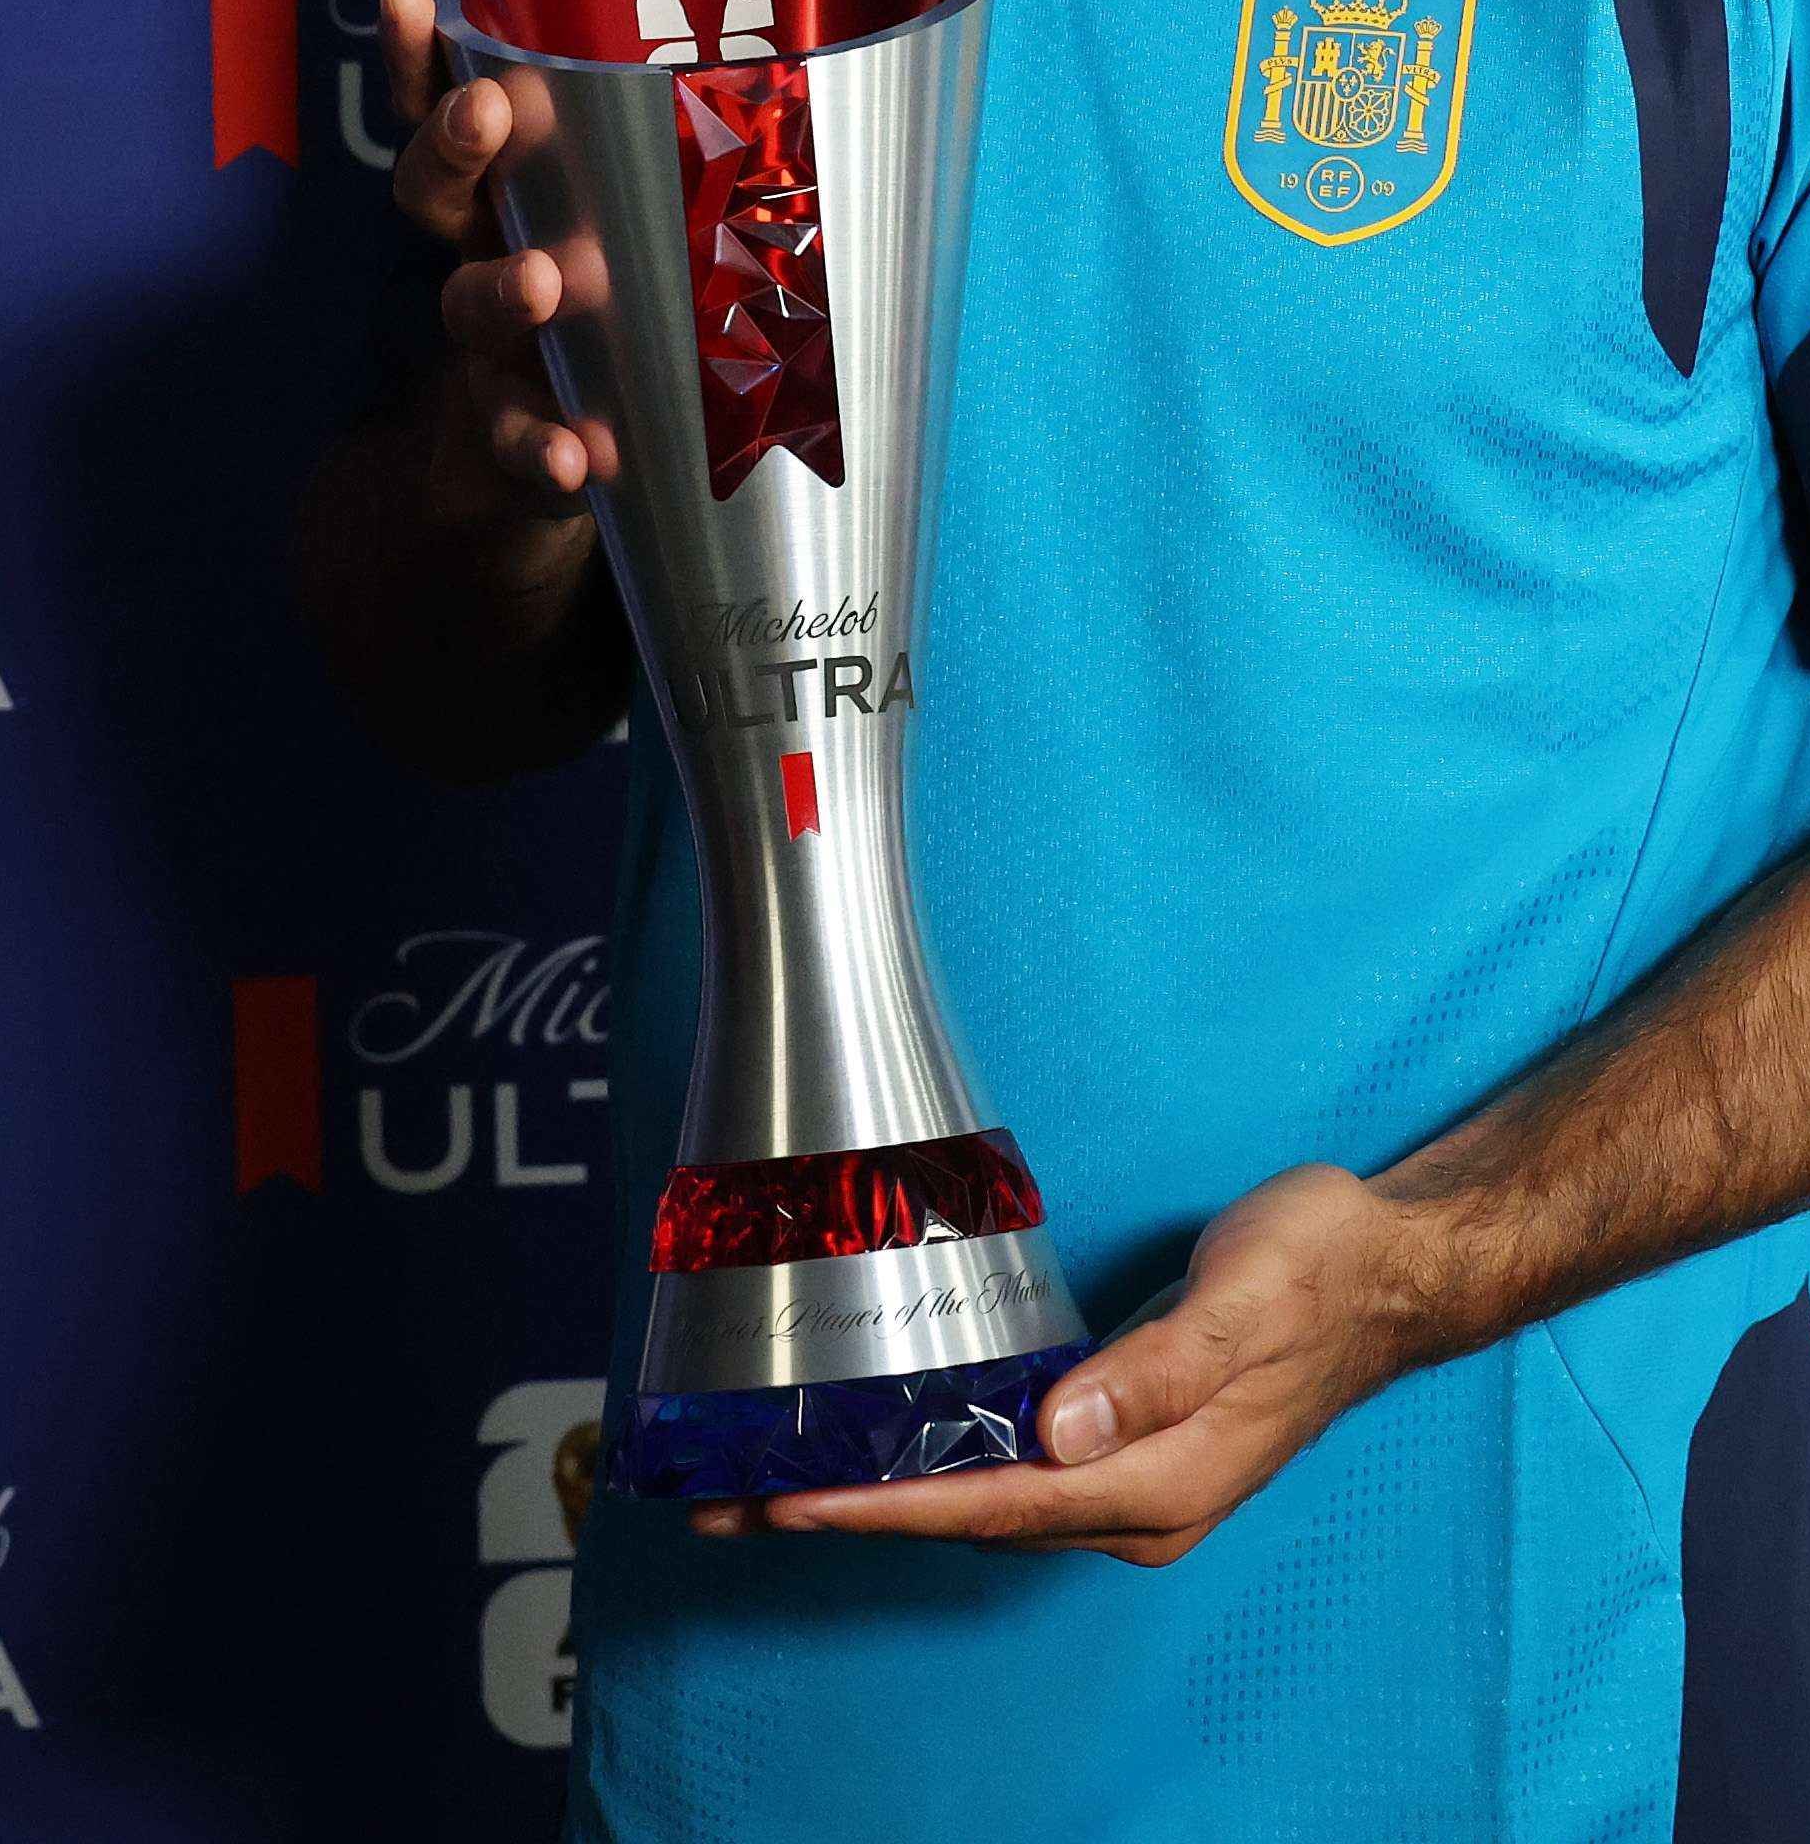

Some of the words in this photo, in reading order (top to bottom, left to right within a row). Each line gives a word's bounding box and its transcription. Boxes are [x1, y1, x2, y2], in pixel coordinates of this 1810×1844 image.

[1279, 172, 1300, 189] 19
[1321, 169, 1353, 183] RF
[1319, 185, 1352, 199] EF
[1371, 180, 1396, 197] 09
